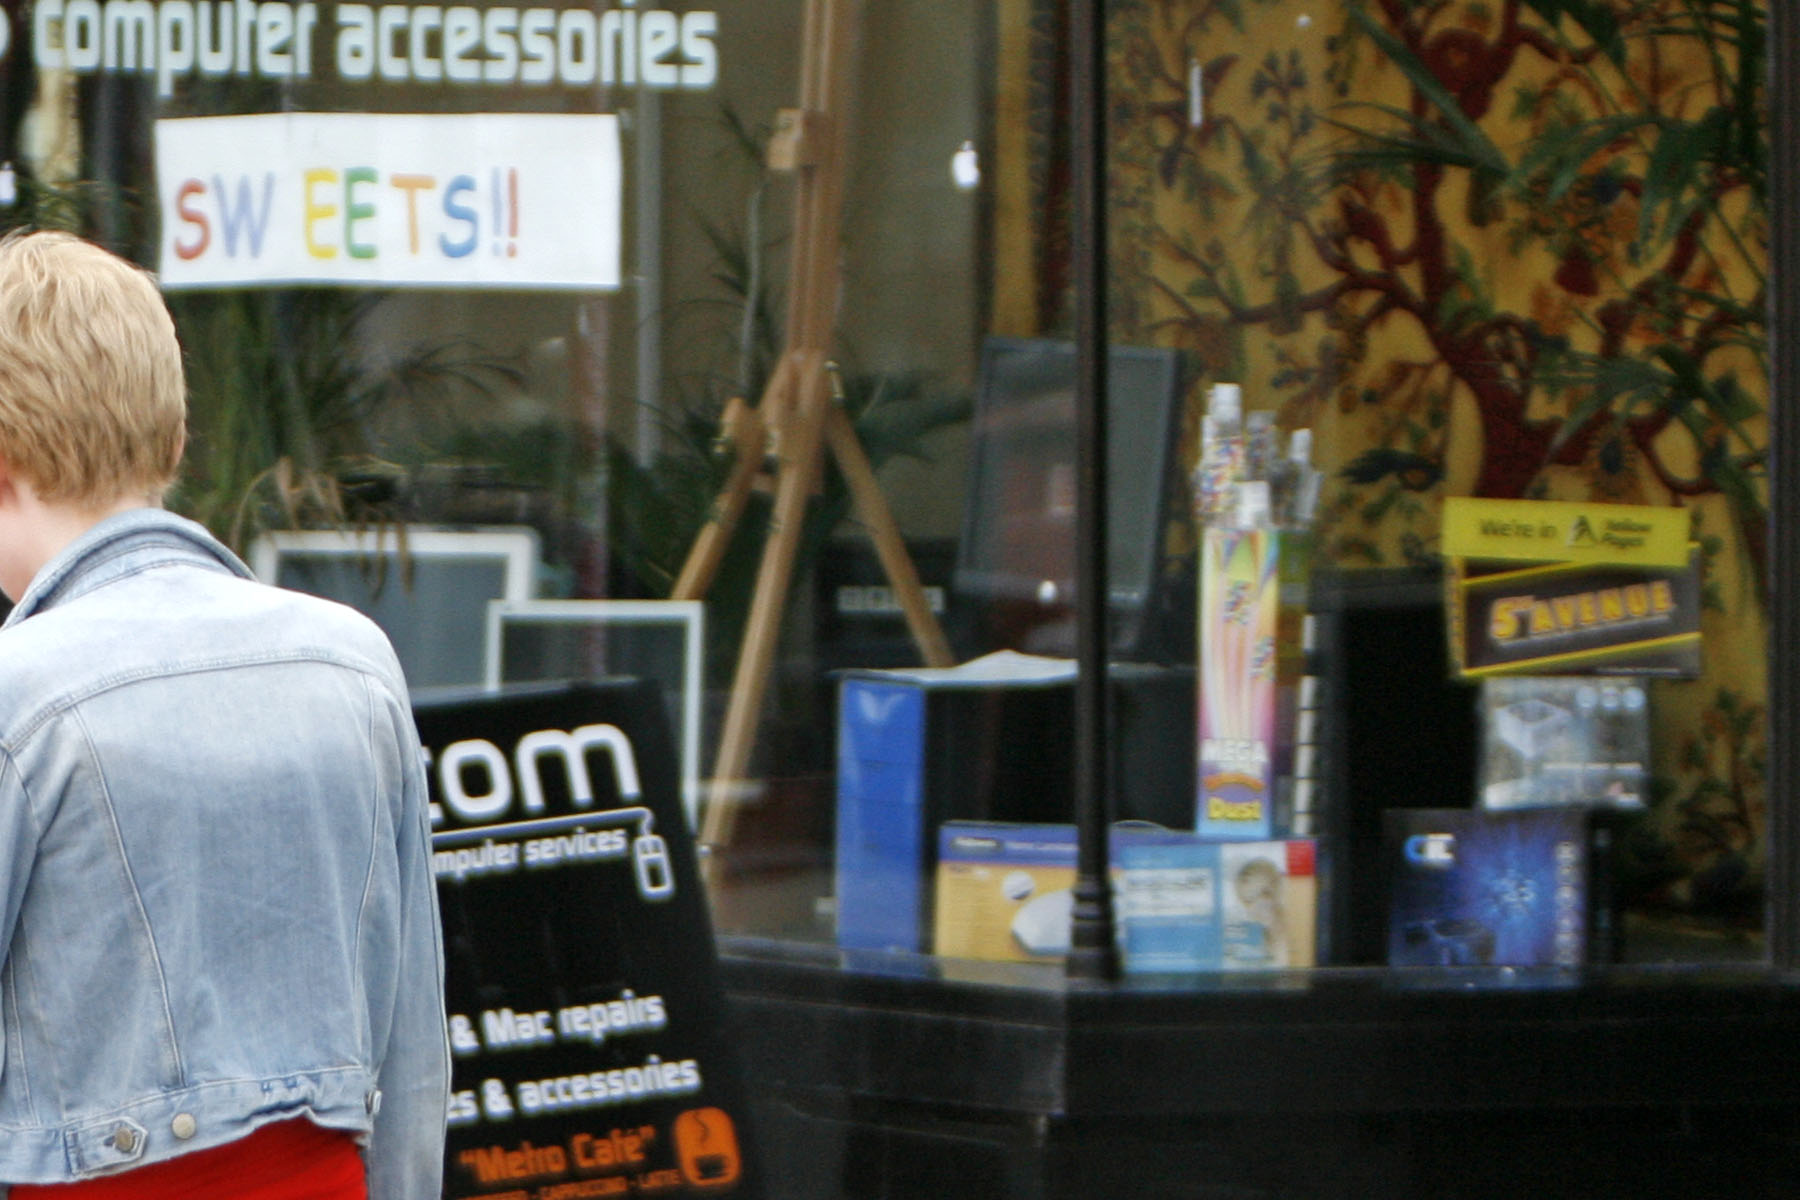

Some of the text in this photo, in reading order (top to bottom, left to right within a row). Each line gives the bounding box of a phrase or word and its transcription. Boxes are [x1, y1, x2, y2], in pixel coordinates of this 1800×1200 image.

[32, 0, 718, 98] computer accessories
[422, 722, 642, 826] om
[432, 826, 628, 882] mputer services
[449, 988, 667, 1054] & Mac repairs
[481, 1078, 513, 1120] &
[517, 1054, 701, 1116] accessories
